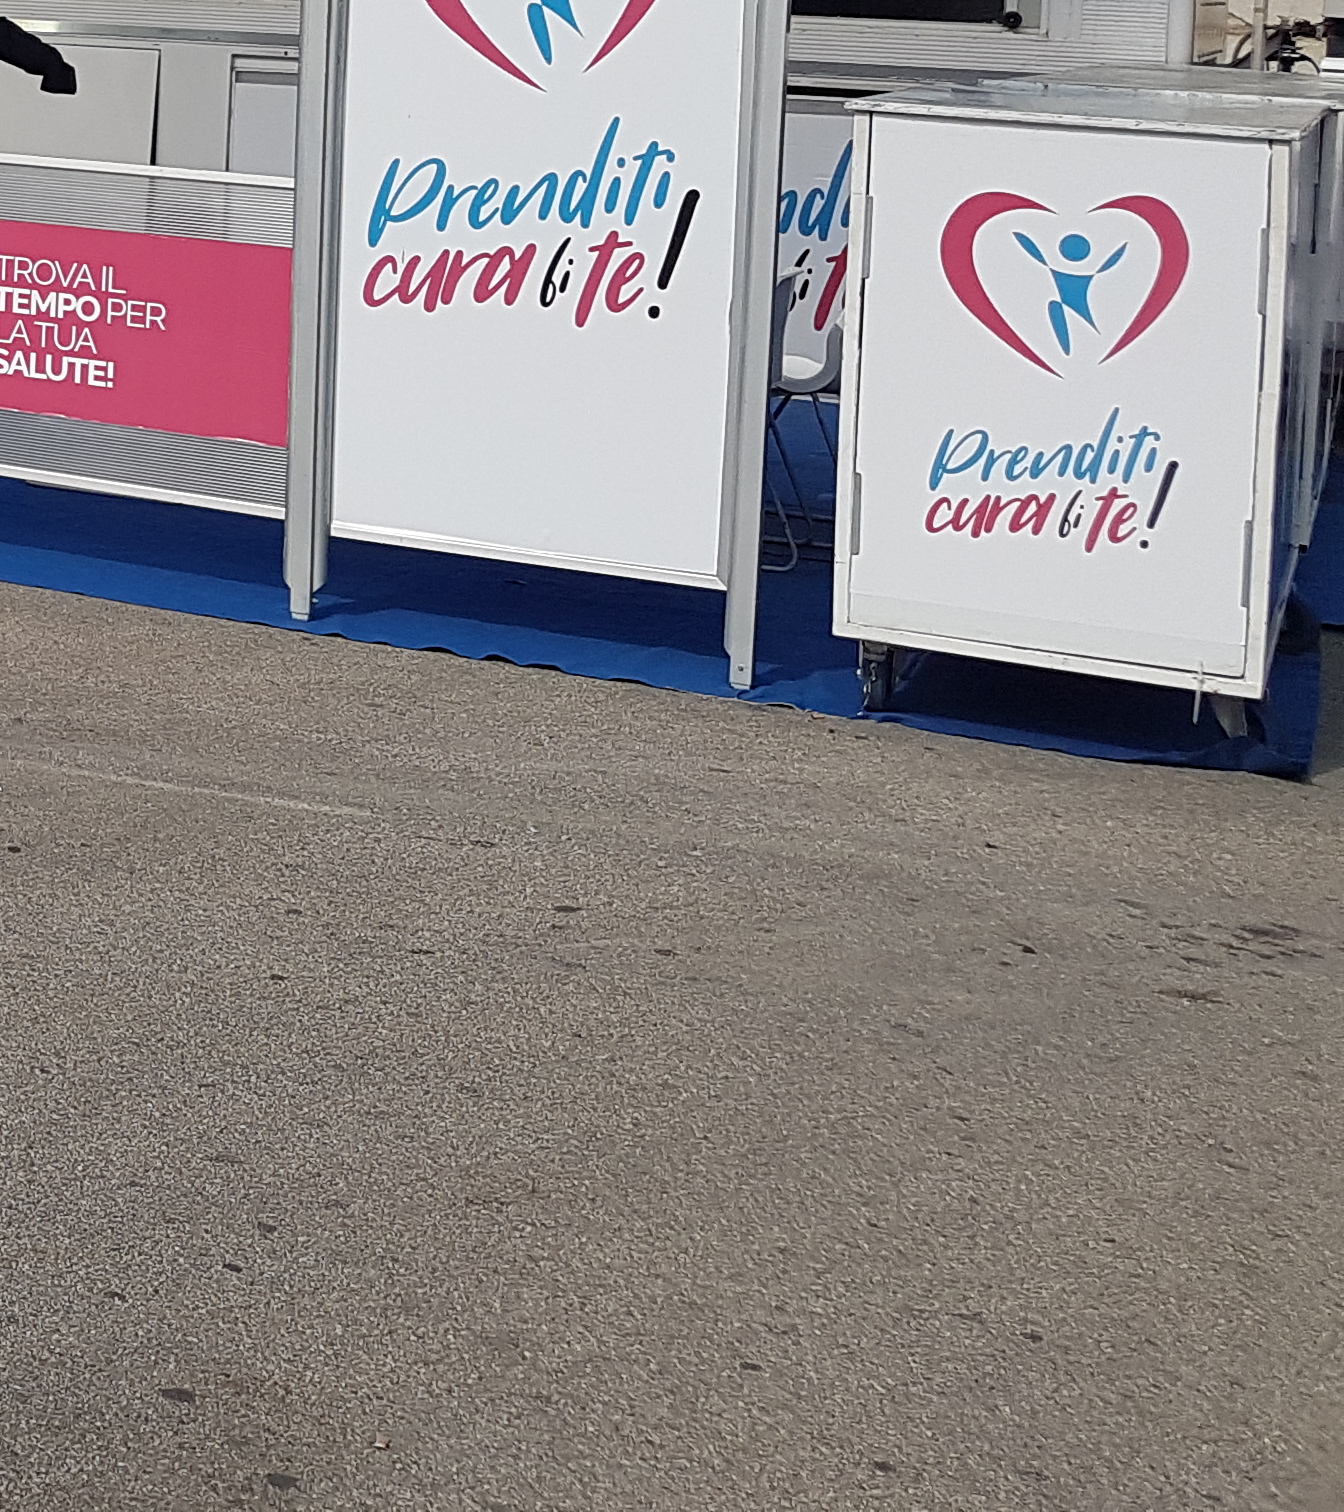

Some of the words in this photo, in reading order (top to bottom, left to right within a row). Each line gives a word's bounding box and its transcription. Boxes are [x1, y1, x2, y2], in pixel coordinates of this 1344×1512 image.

[368, 116, 675, 247] Prenditi
[102, 266, 127, 294] IL
[363, 243, 537, 312] cura
[575, 189, 701, 328] te!
[34, 321, 97, 354] TUA
[107, 298, 166, 331] PER
[929, 406, 1161, 491] Prenditi
[925, 492, 1057, 538] cura
